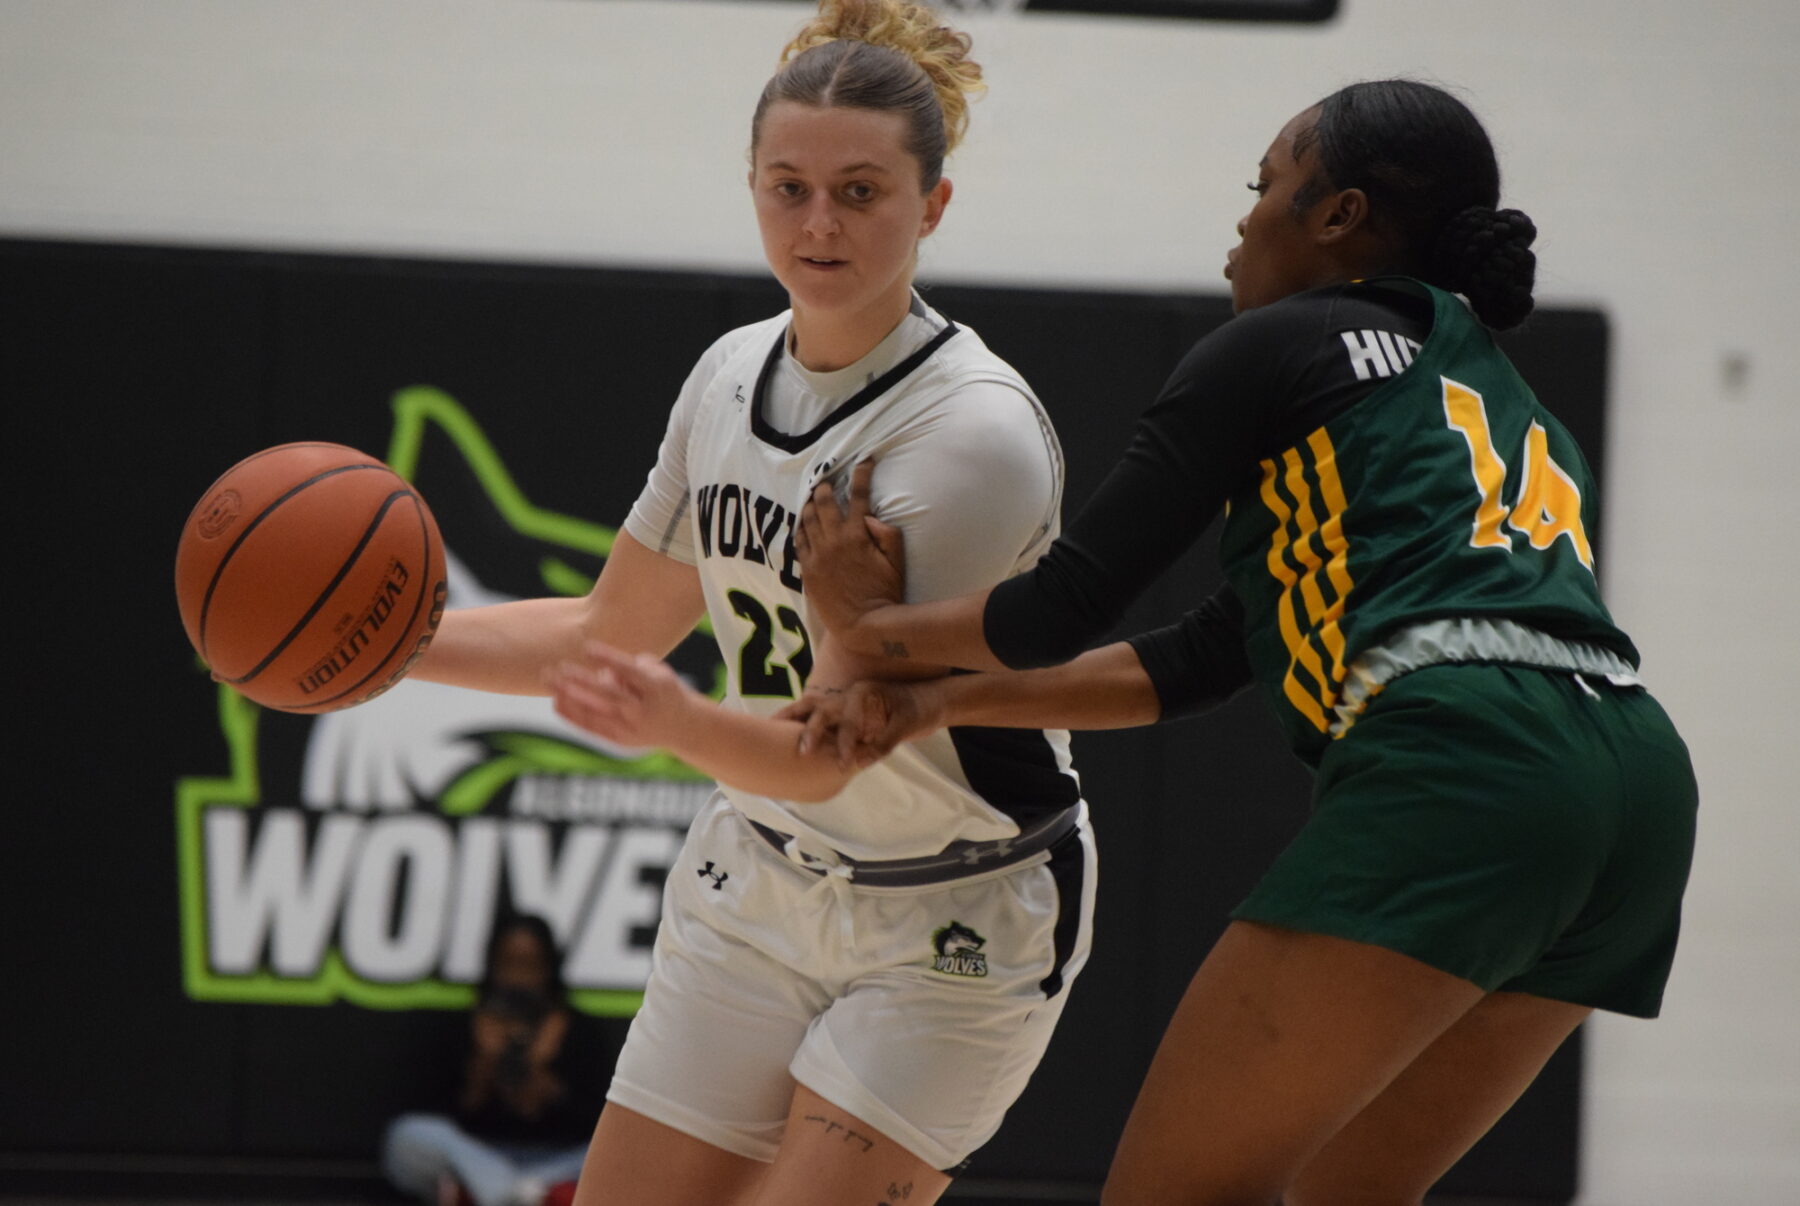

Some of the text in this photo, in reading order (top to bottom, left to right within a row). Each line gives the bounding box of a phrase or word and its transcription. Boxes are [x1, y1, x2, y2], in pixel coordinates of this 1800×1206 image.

[697, 484, 802, 594] WOLVE
[1440, 375, 1594, 576] 14
[299, 560, 409, 694] EVOLUTION
[205, 809, 685, 990] WOLVE
[935, 956, 987, 976] WOLVES
